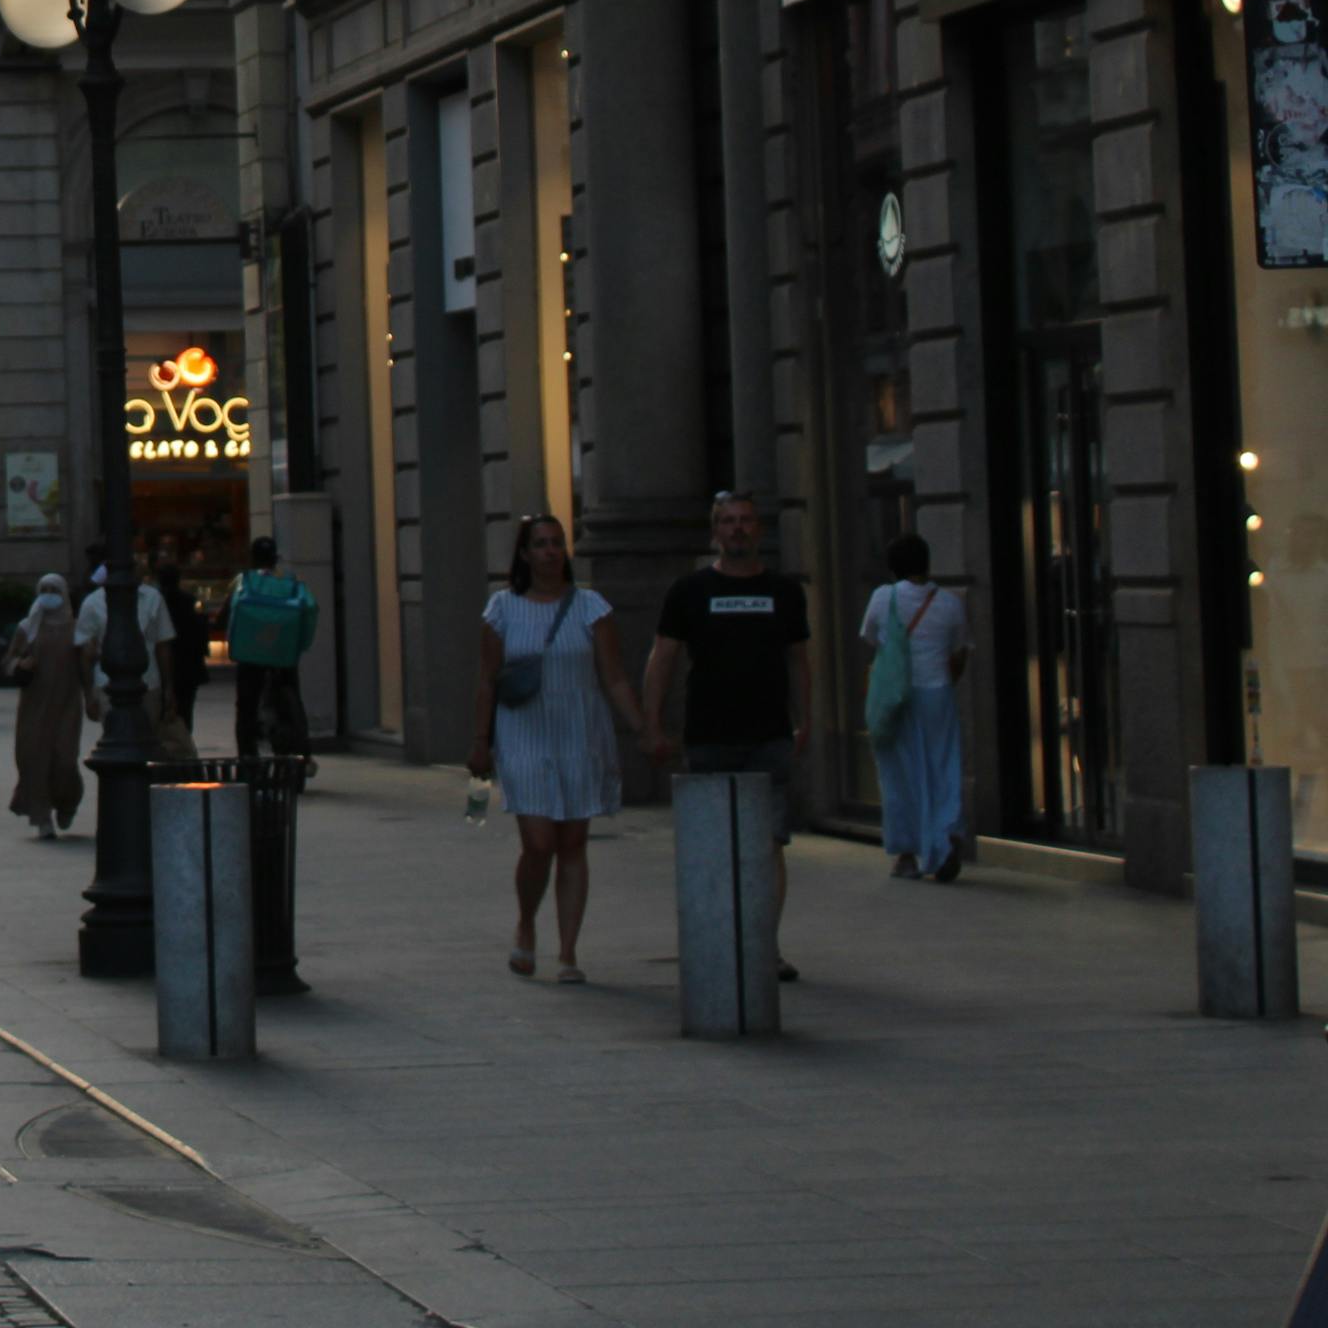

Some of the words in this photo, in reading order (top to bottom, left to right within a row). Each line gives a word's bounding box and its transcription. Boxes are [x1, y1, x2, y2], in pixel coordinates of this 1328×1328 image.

[160, 390, 250, 442] Vog
[129, 439, 199, 460] ELATO
[224, 439, 251, 458] GA
